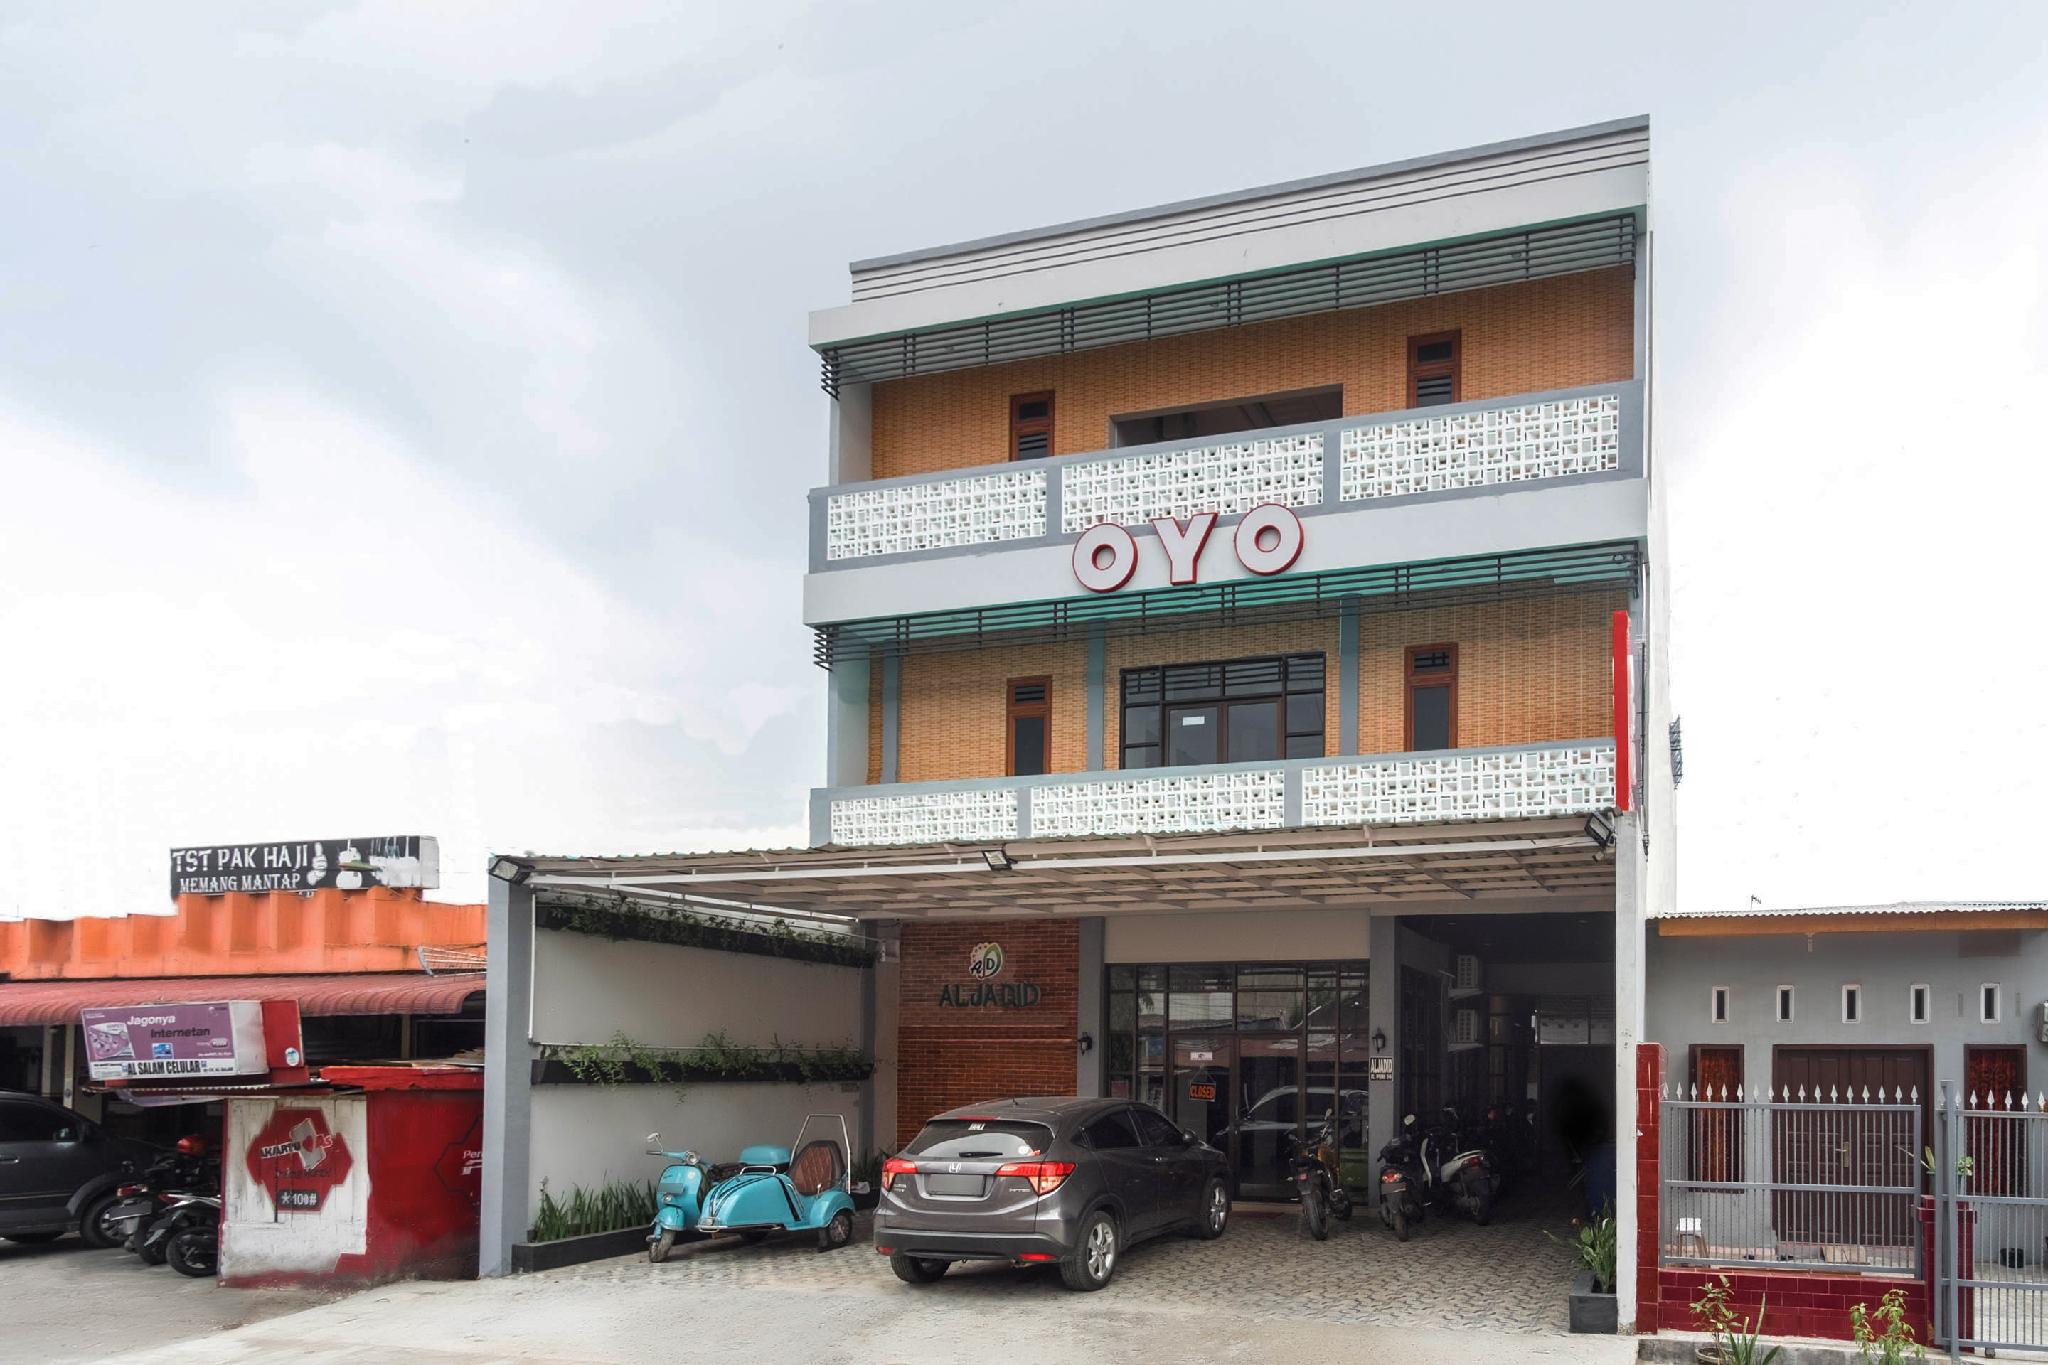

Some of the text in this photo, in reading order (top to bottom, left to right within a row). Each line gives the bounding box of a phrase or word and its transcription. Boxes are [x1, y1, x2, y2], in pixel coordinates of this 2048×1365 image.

[1072, 503, 1304, 594] OYO
[172, 844, 308, 873] TST PAK HAJI
[180, 873, 300, 893] MEMANG MANTAP
[127, 1015, 176, 1027] Jagonya
[151, 1028, 210, 1038] Internetan
[127, 1062, 137, 1076] AL
[138, 1061, 165, 1075] SALAM
[166, 1060, 201, 1074] CELULAR
[1190, 1085, 1215, 1099] CLOSED
